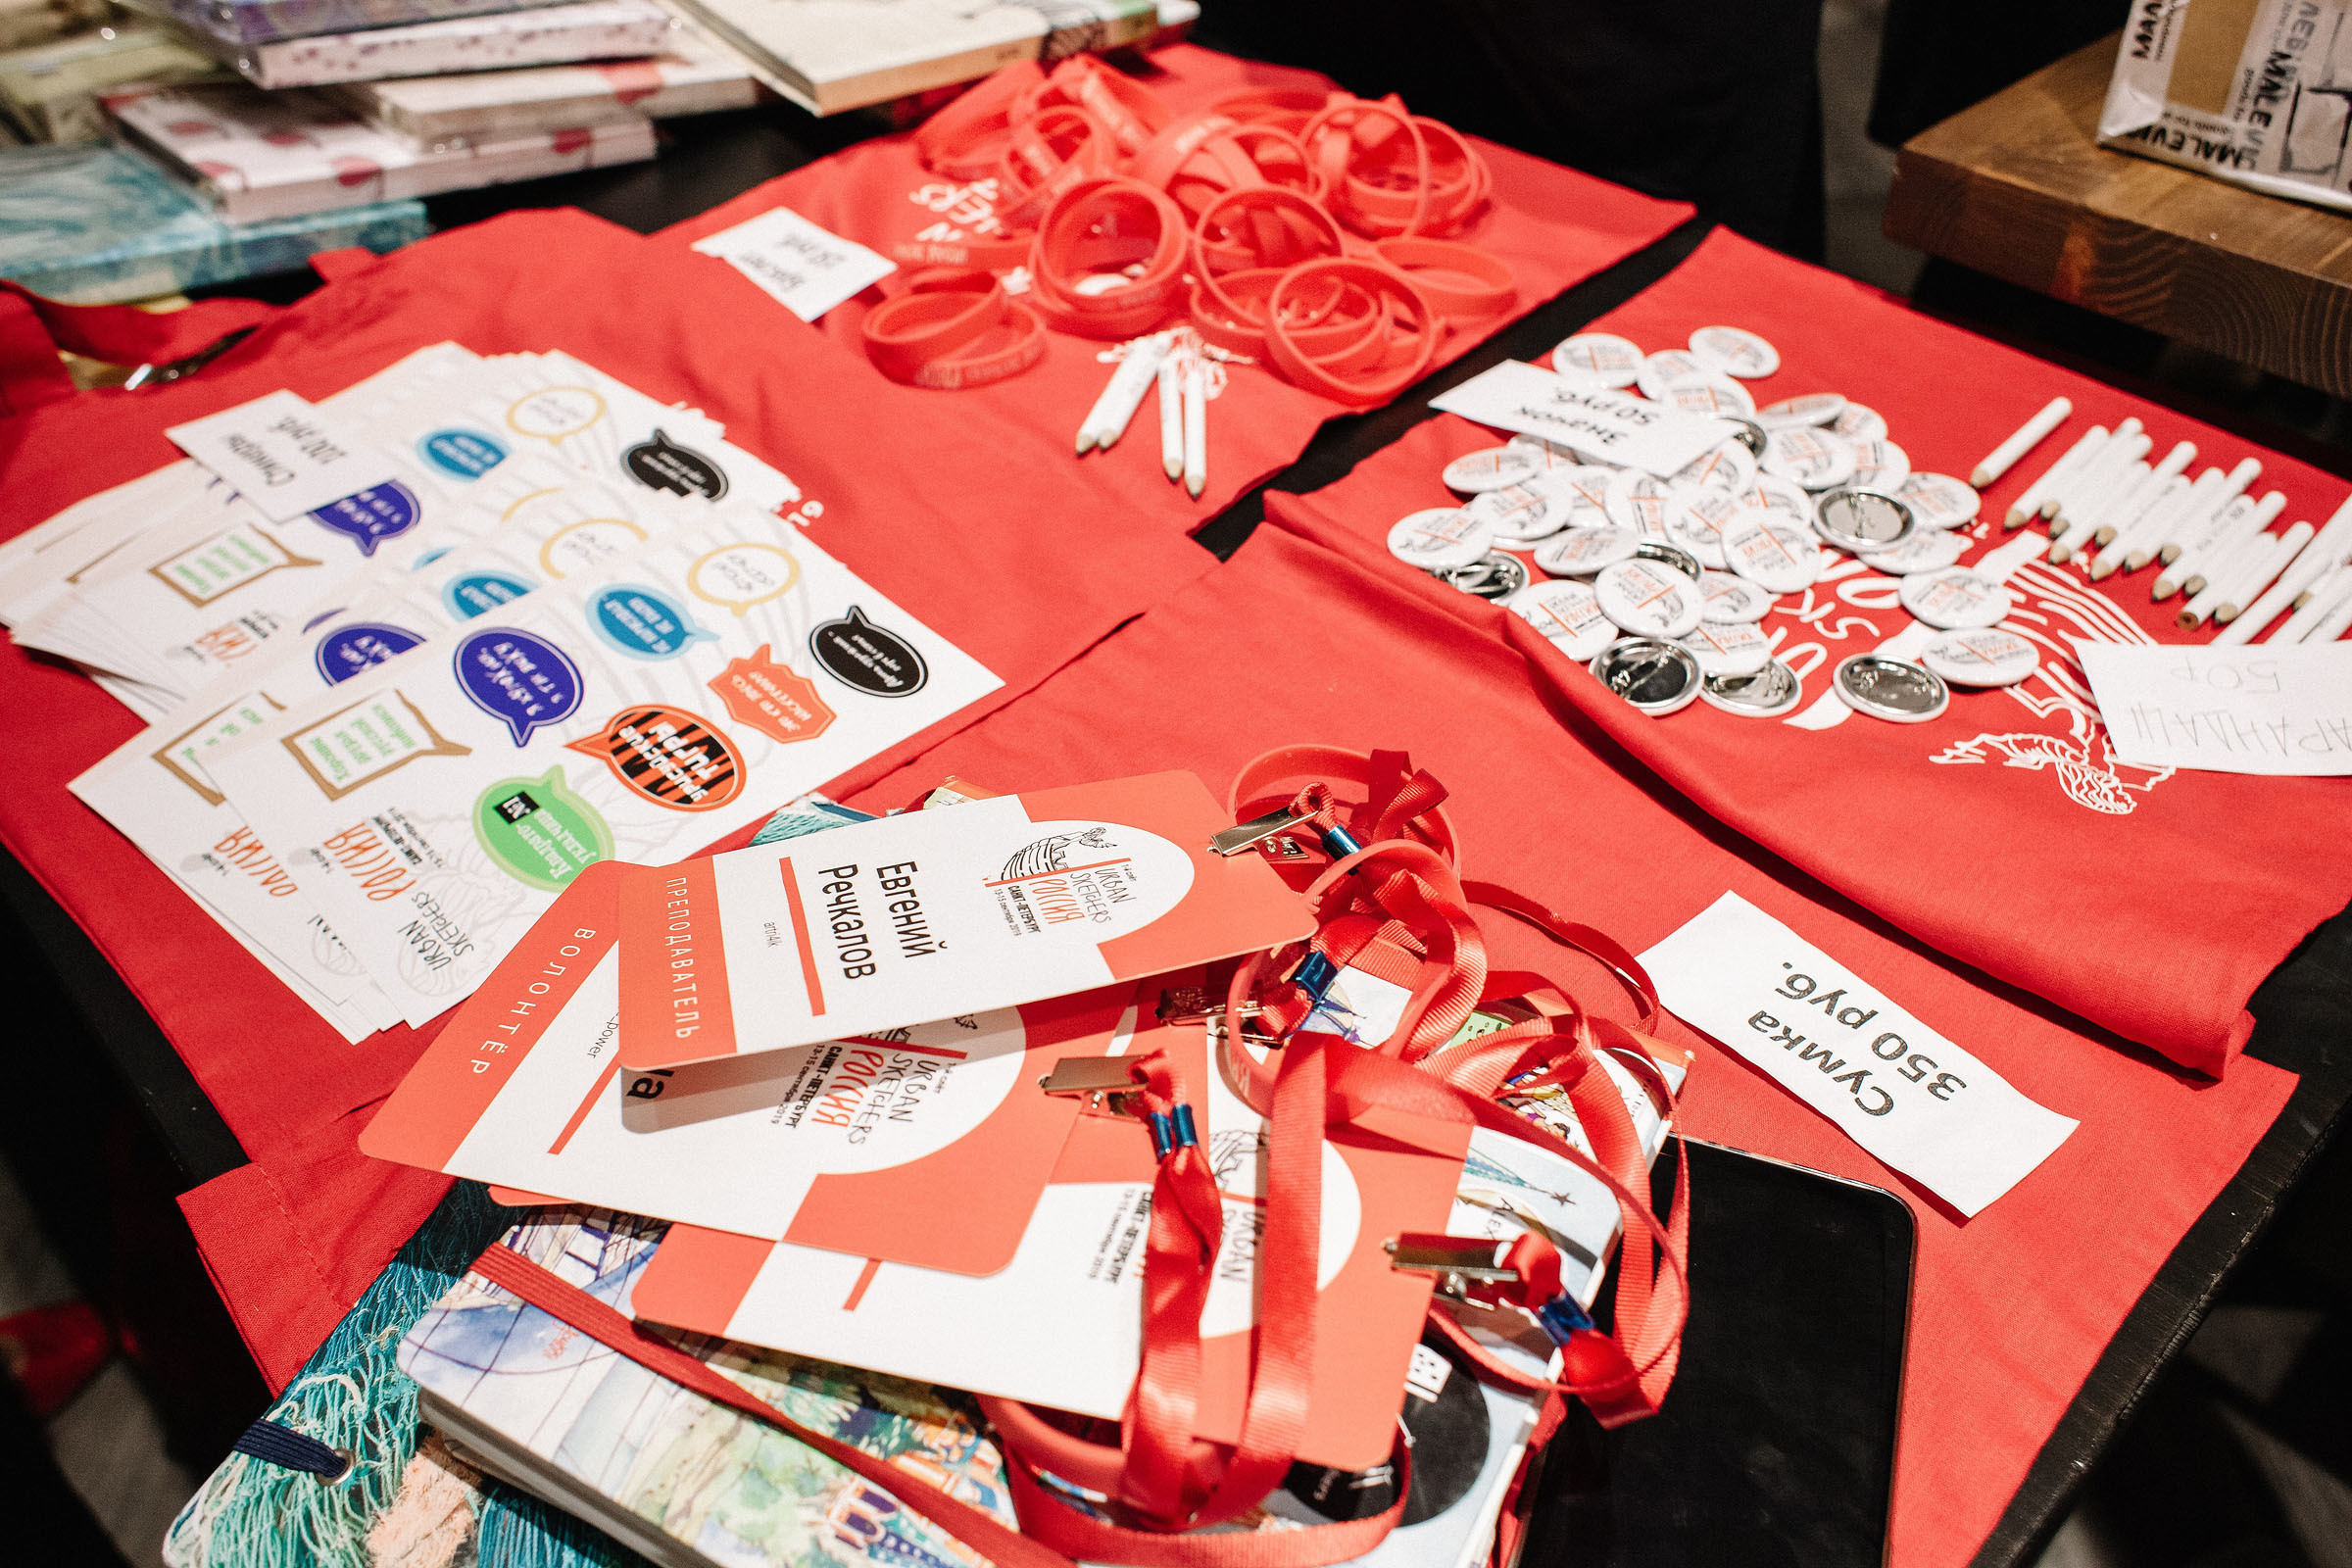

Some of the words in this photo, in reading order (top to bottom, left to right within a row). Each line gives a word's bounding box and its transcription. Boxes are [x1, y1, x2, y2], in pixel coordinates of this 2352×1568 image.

[2130, 701, 2352, 758] АРАНДАШ
[322, 821, 417, 902] РОССИЯ
[1094, 867, 1138, 905] URBAN
[411, 891, 474, 957] SKETCHERS
[818, 863, 877, 980] Речкалов
[875, 859, 949, 960] Евгений
[1028, 878, 1086, 924] РОССИЯ
[1069, 871, 1112, 924] SKETCHERS
[397, 919, 453, 971] URBAN
[665, 877, 701, 1040] ПРЕПОДАВАТЕЛЬ
[469, 926, 598, 1075] ВОЛОНТЁР
[1774, 961, 1880, 1030] руб.
[587, 1011, 619, 1058] _power
[808, 1044, 825, 1066] 13-15
[1746, 1008, 1895, 1118] Сумка
[1870, 1031, 1968, 1102] 350
[786, 1045, 843, 1128] САНКТ-ПЕТЕРБУРГ
[811, 1050, 885, 1127] РОССИЯ
[848, 1053, 913, 1145] SKETCHERS
[888, 1059, 940, 1122] URBAN
